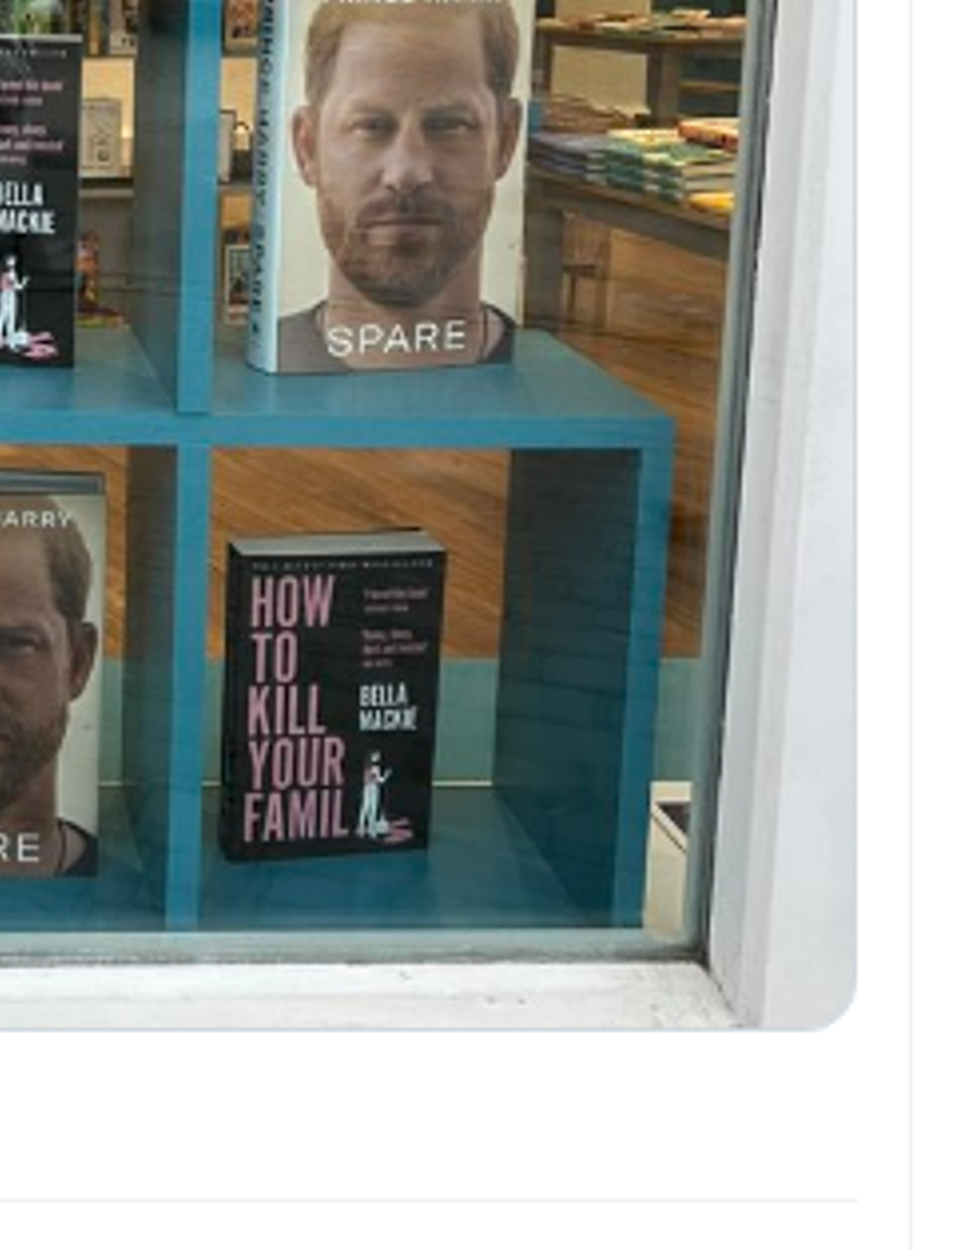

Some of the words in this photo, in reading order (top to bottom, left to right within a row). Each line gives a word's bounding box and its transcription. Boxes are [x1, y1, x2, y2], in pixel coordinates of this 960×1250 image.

[326, 321, 466, 356] SPARE
[250, 574, 337, 628] HOW
[249, 632, 298, 683] TO
[247, 685, 328, 735] KILL
[359, 682, 408, 707] BELLA
[359, 706, 418, 731] MACKIE
[248, 737, 346, 790] YOUR
